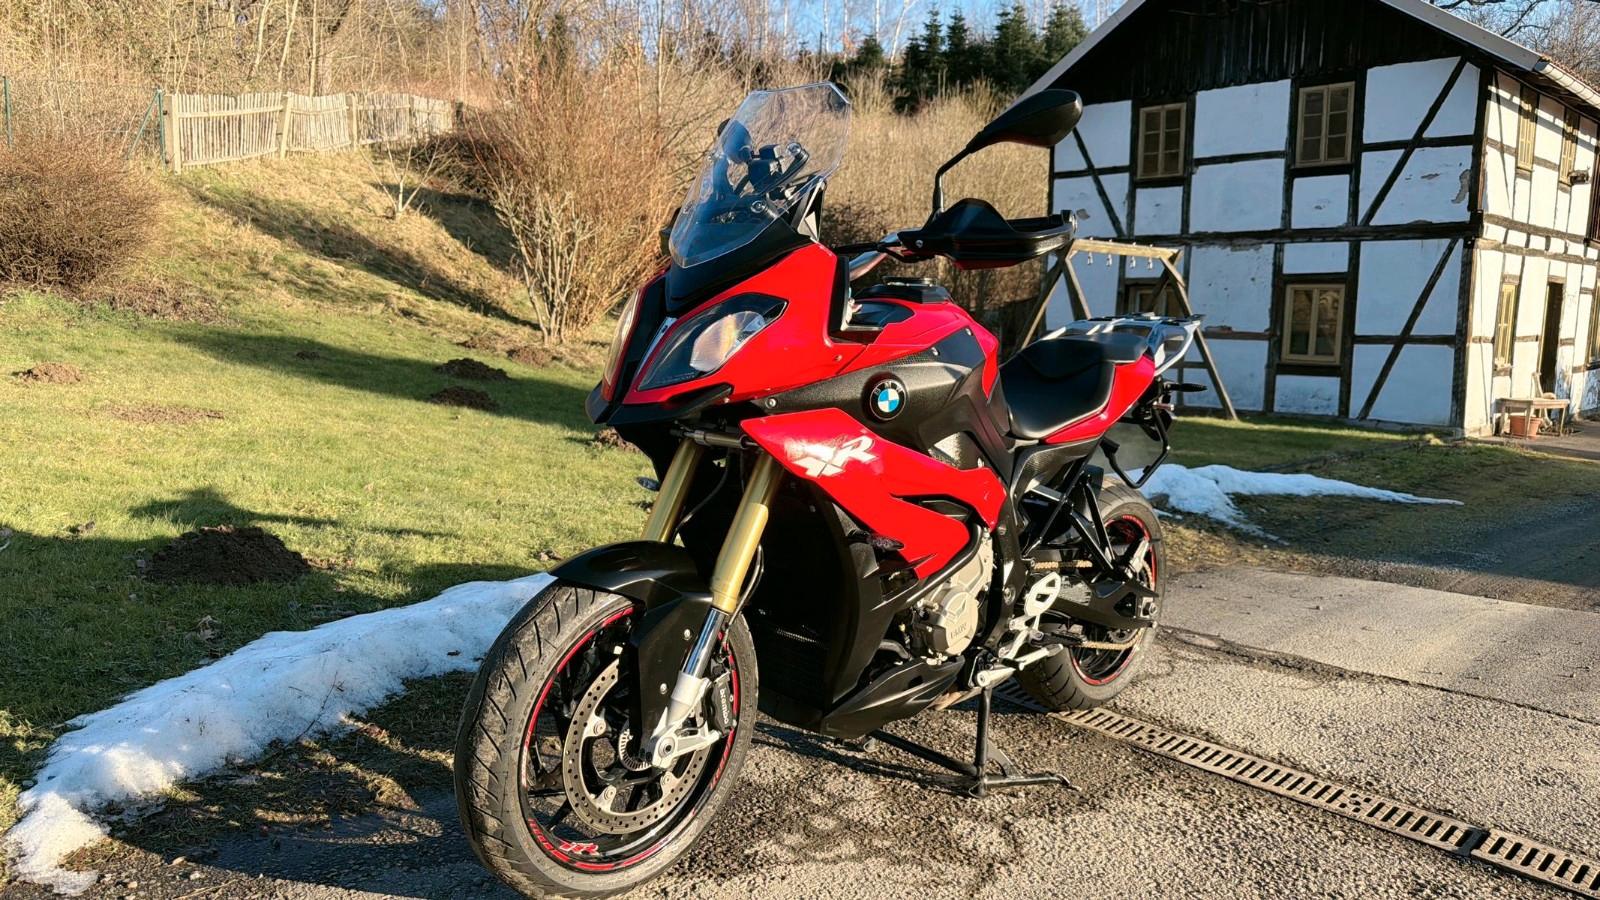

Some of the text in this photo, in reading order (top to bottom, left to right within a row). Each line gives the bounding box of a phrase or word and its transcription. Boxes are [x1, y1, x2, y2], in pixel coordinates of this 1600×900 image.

[873, 380, 904, 395] BMW
[791, 435, 879, 479] XR
[720, 687, 729, 725] brembo
